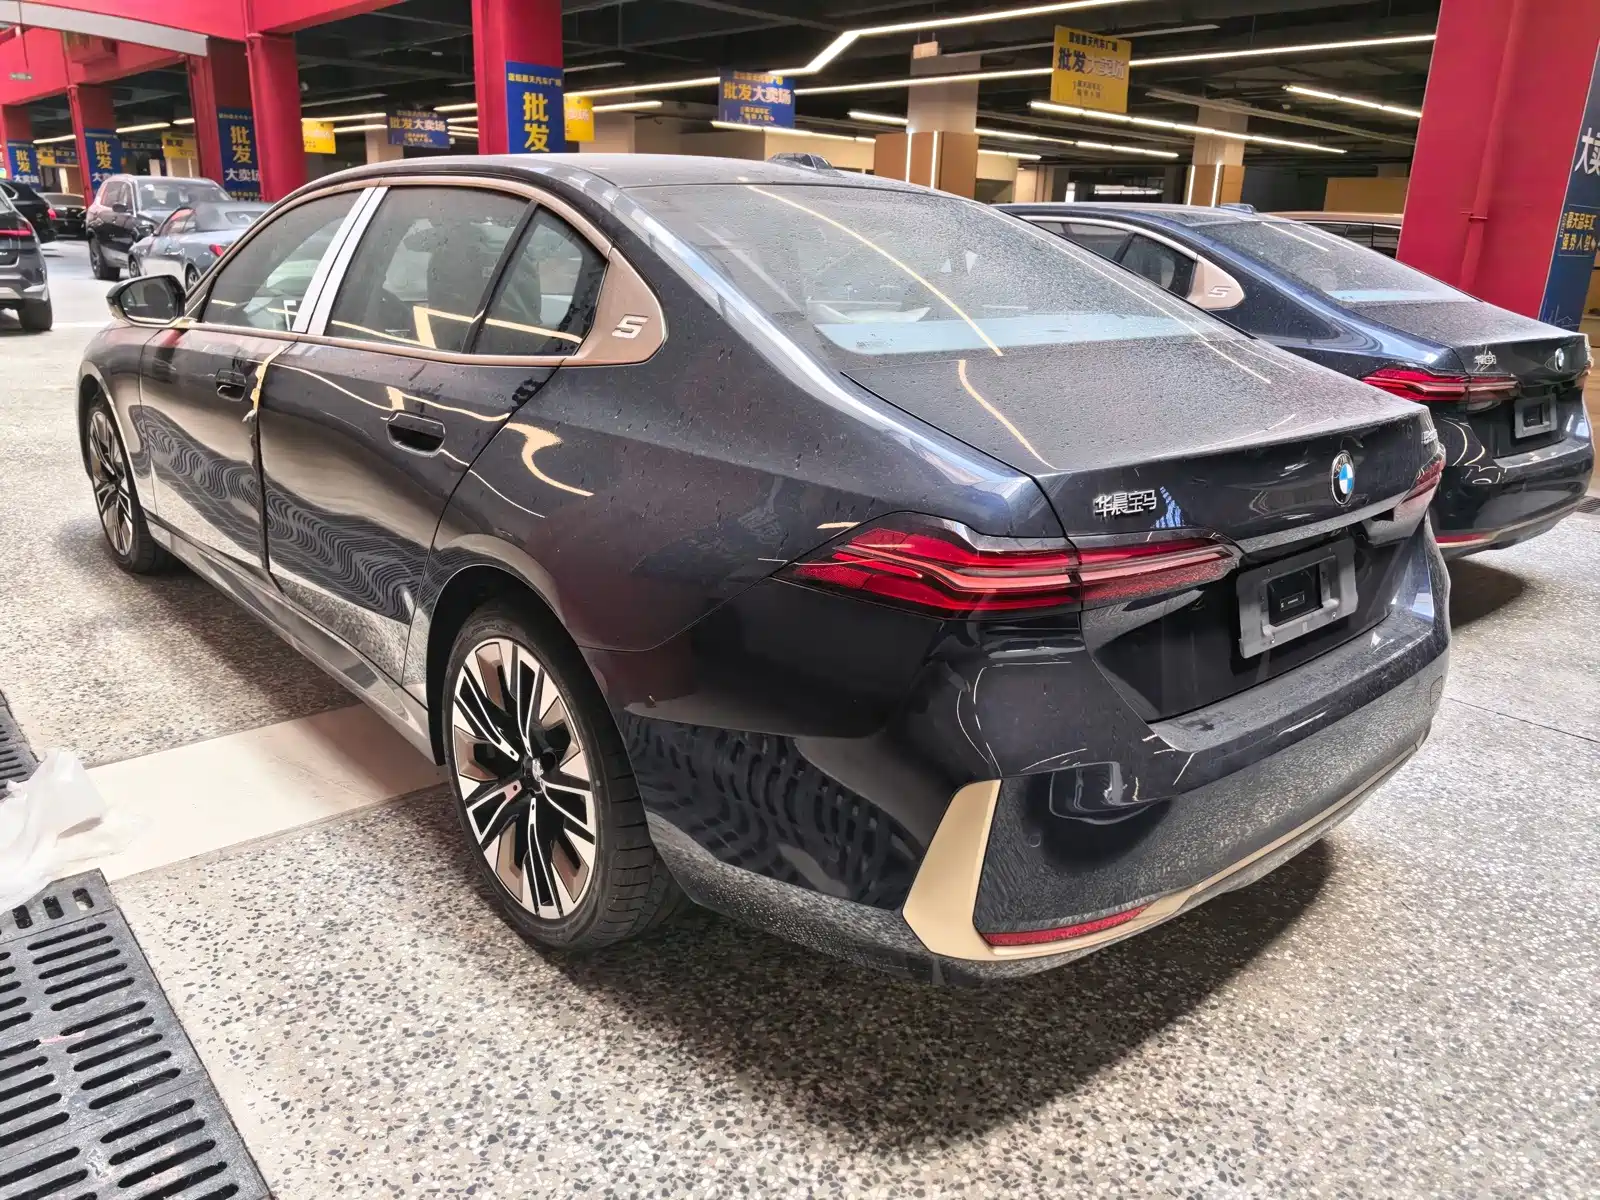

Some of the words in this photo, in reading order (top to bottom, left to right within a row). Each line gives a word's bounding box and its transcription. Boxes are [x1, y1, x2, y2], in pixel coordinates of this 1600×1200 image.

[724, 81, 791, 104] 批发大卖场
[523, 92, 550, 152] 批发
[230, 126, 252, 164] 批发
[611, 313, 650, 339] 5
[1094, 489, 1157, 518] 华晨宝马
